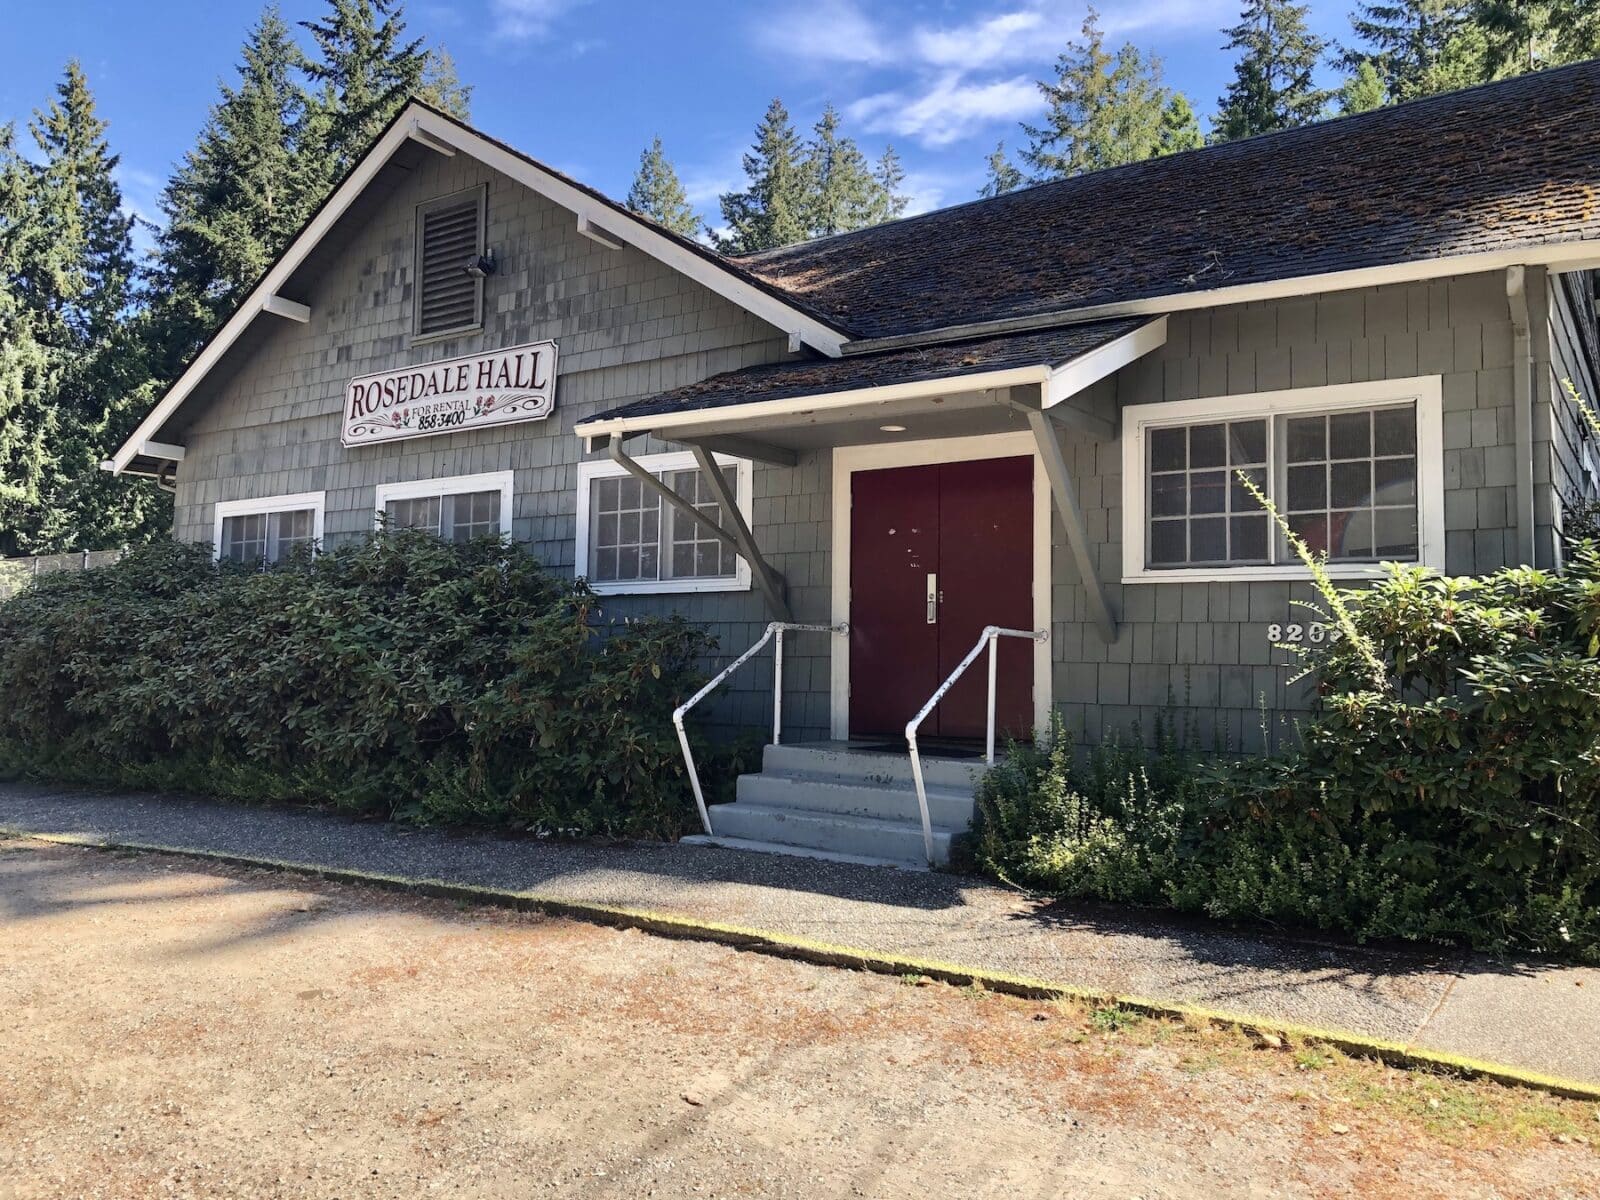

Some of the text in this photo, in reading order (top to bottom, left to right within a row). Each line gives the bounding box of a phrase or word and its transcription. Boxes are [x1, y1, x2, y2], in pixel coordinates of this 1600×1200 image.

[350, 351, 547, 419] ROSEDALE HALL
[412, 400, 471, 419] FOR RENTAL
[418, 410, 465, 430] 858-3400
